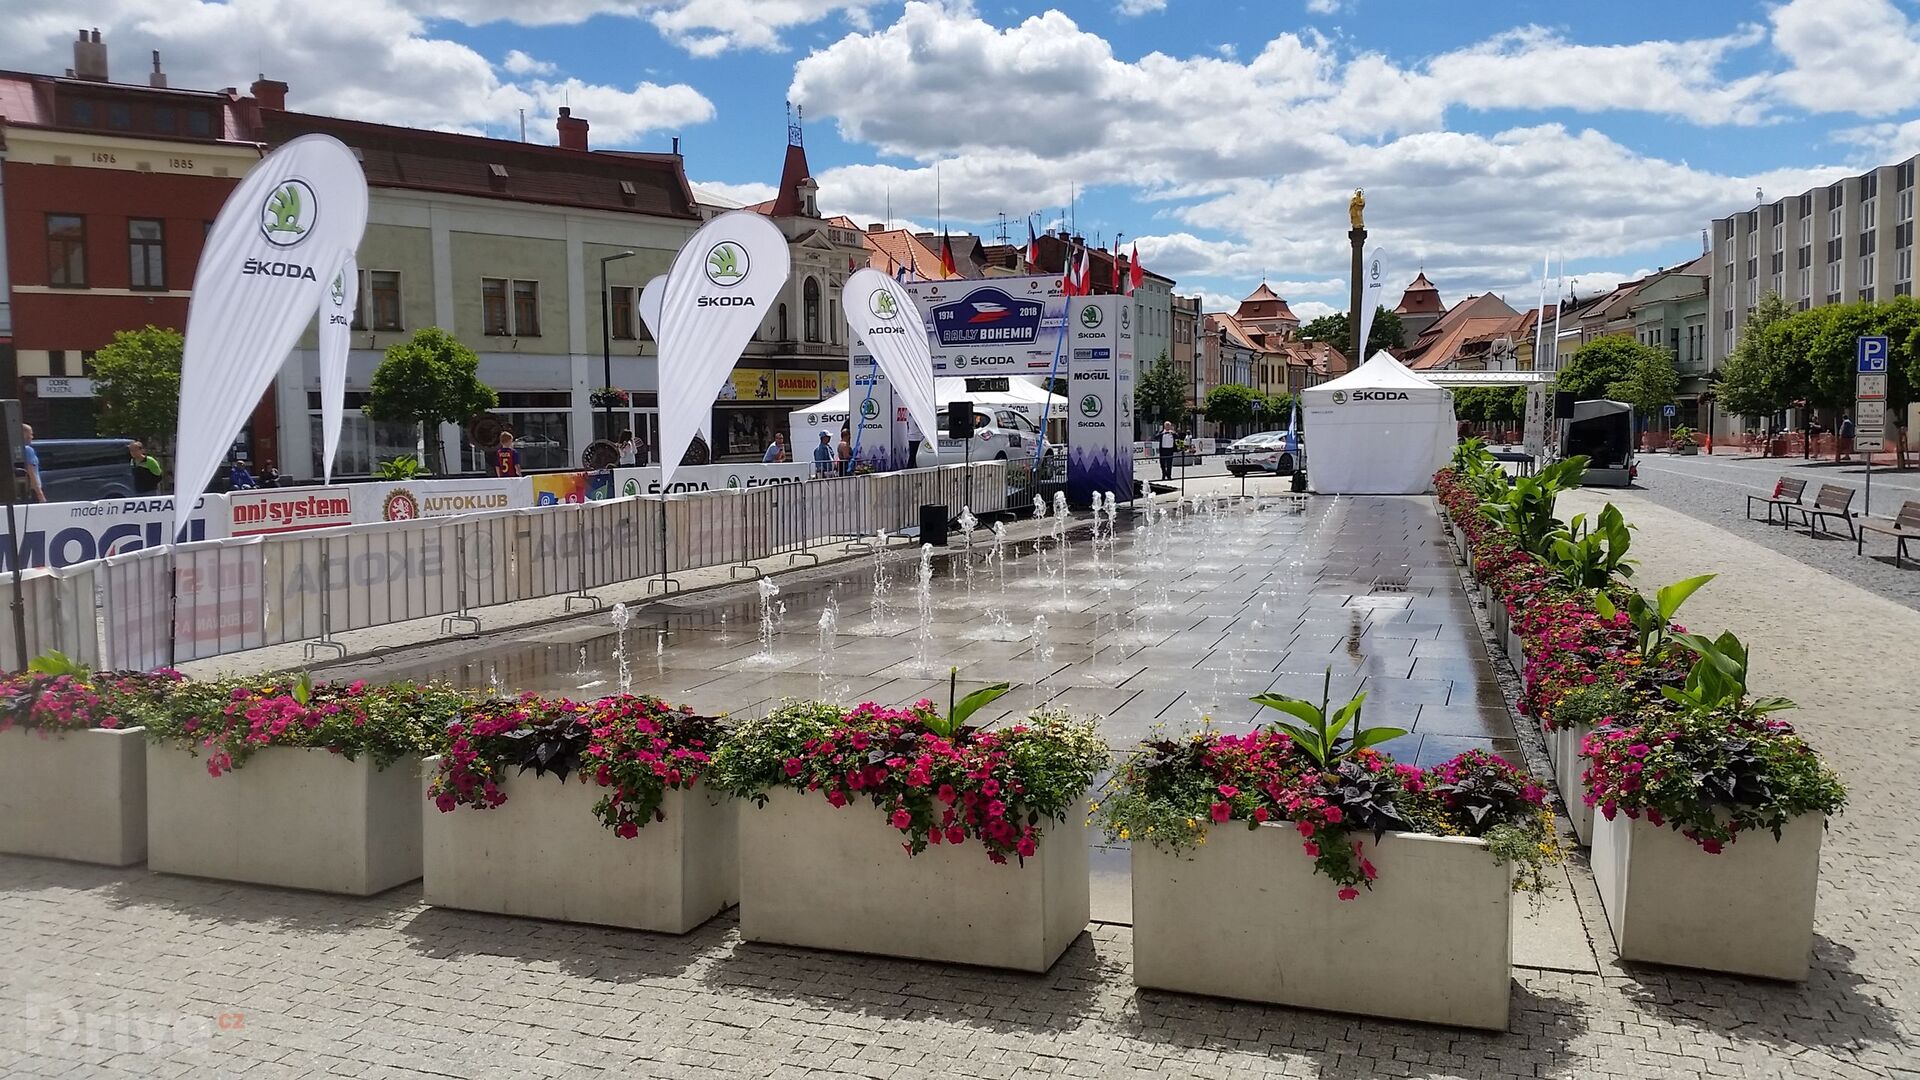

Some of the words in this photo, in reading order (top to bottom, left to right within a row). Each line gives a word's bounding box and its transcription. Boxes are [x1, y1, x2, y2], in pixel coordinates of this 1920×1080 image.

[92, 152, 117, 163] 1696
[169, 159, 194, 169] 1885
[242, 258, 317, 281] ŠKODA
[697, 295, 756, 307] ŠKODA
[938, 310, 954, 320] 1974
[1019, 307, 1037, 317] 2018
[943, 329, 978, 342] RALLY
[980, 327, 1033, 340] BOHEMIA
[1864, 340, 1882, 361] P
[970, 355, 1015, 366] ŠKODA
[1074, 372, 1110, 380] MOGUL
[1352, 390, 1409, 401] ŠKODA
[821, 413, 850, 423] ŠKOD
[502, 458, 509, 473] 5
[71, 503, 103, 517] made
[106, 503, 118, 515] in
[122, 497, 205, 514] PARAO
[423, 494, 508, 512] AUTOKLUB
